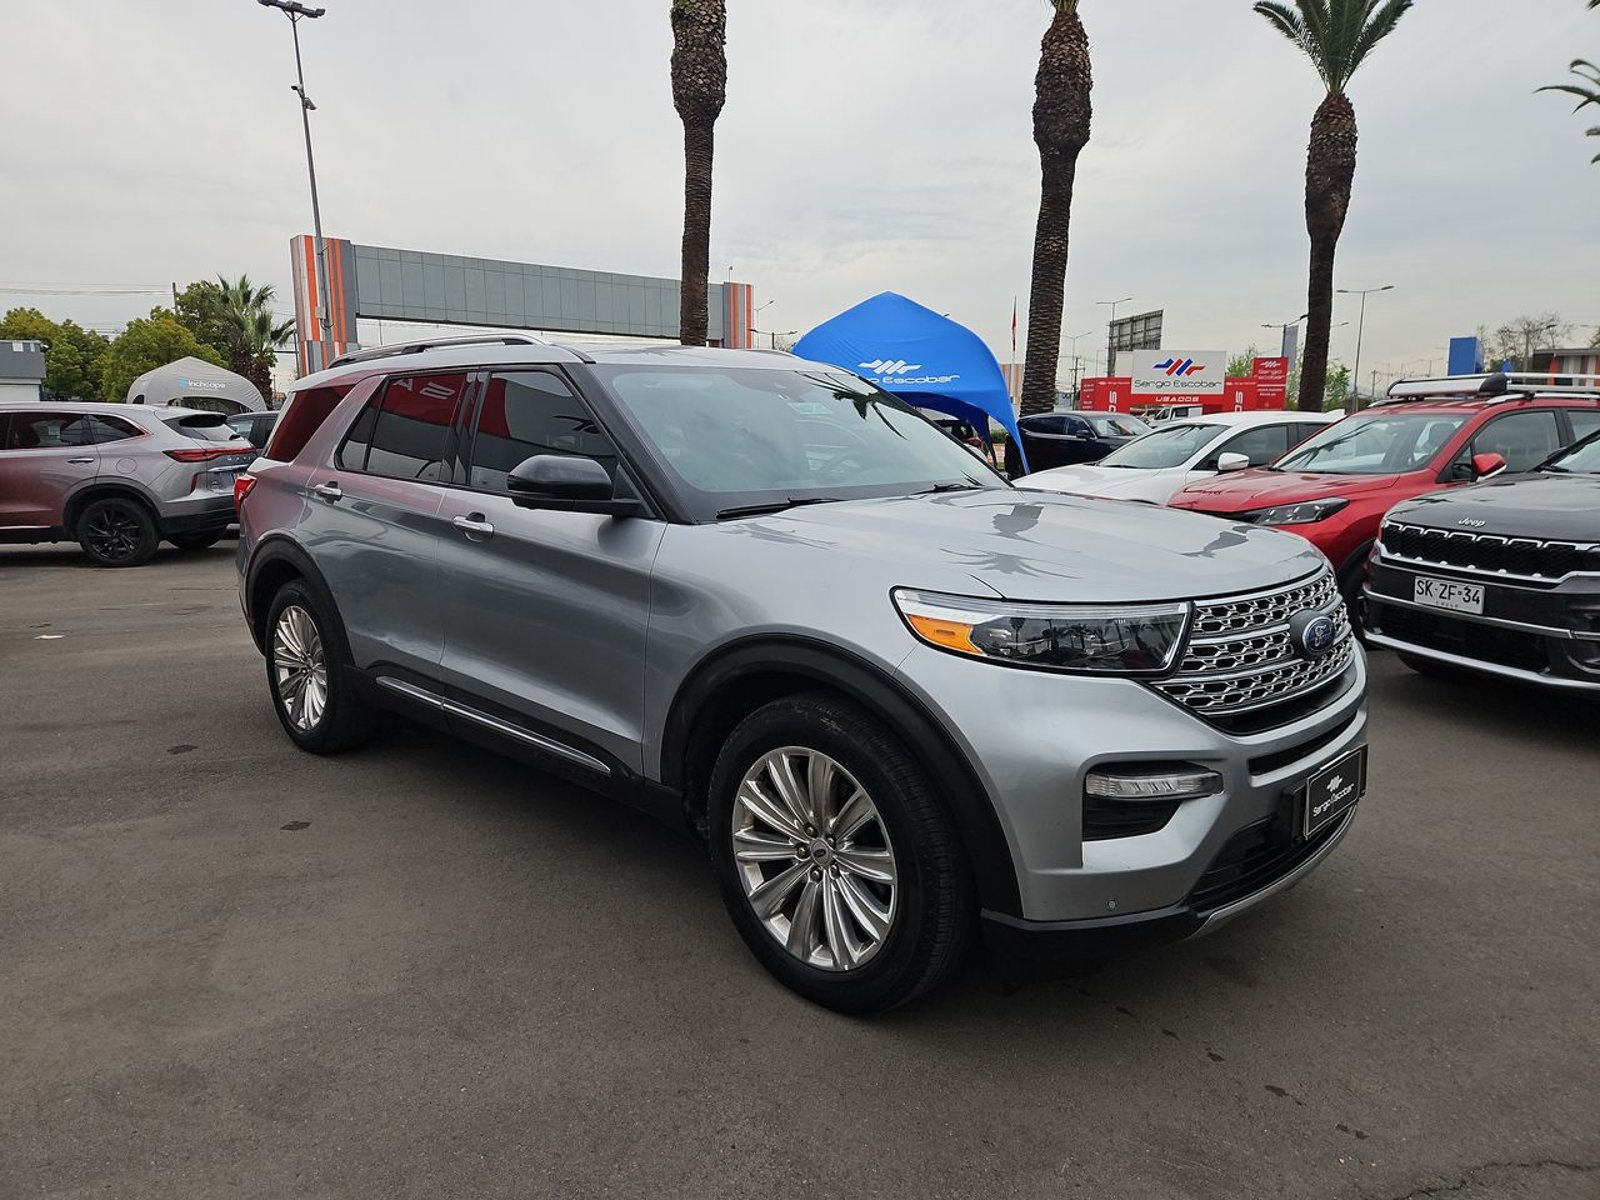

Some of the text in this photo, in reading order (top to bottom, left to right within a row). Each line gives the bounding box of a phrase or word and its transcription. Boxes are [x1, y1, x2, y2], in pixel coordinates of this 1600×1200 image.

[882, 374, 960, 384] Escobar
[1134, 379, 1171, 389] Sergo
[1173, 379, 1222, 388] Escobar
[1458, 517, 1486, 527] Jeep
[1313, 799, 1331, 817] Sergo
